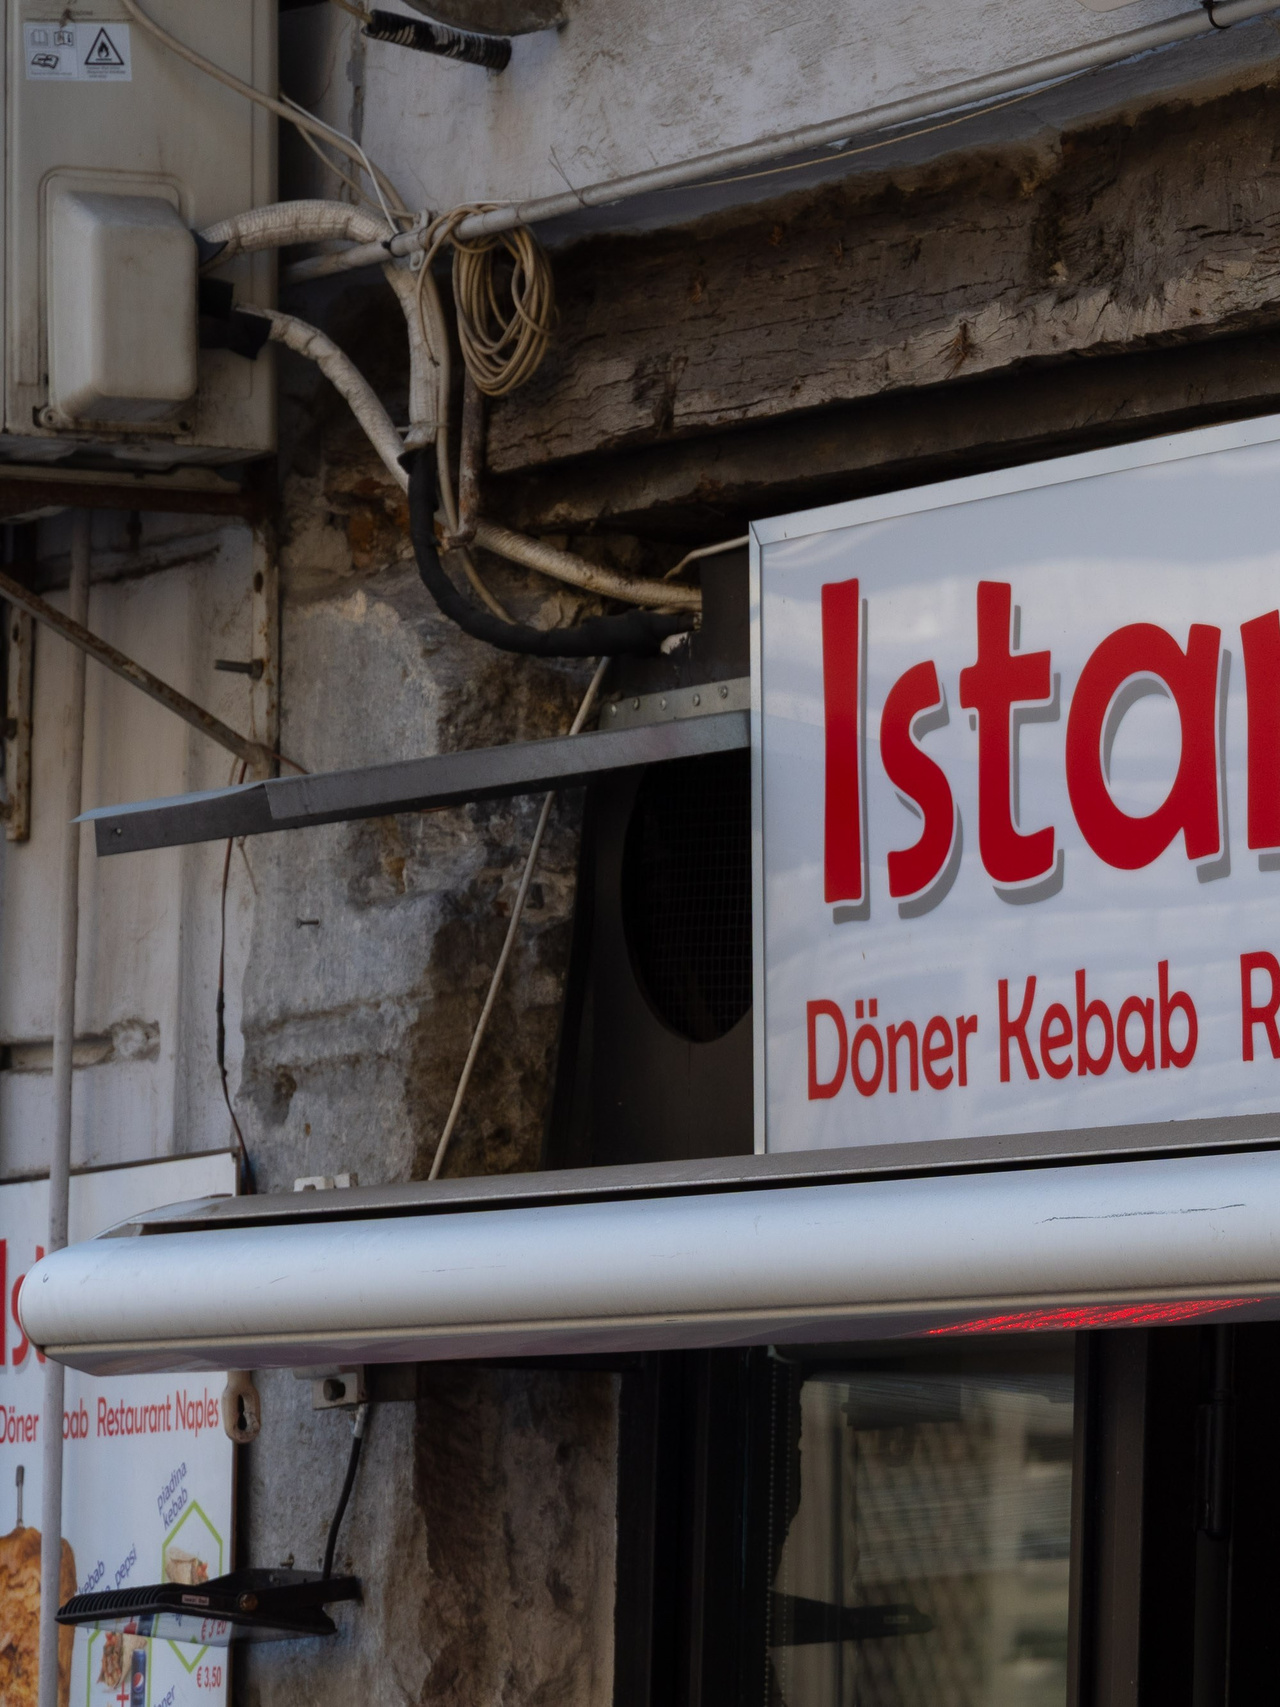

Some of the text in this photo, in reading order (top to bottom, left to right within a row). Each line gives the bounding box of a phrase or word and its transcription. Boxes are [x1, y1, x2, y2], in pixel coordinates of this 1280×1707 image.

[806, 998, 978, 1101] Döner
[997, 959, 1199, 1083] Kebab
[96, 1395, 173, 1437] Restaurant
[174, 1388, 220, 1437] Naples
[156, 1461, 188, 1516] piadina
[162, 1486, 189, 1531] kebab
[115, 1542, 138, 1590] pepsi
[196, 1665, 222, 1692] € 3,50
